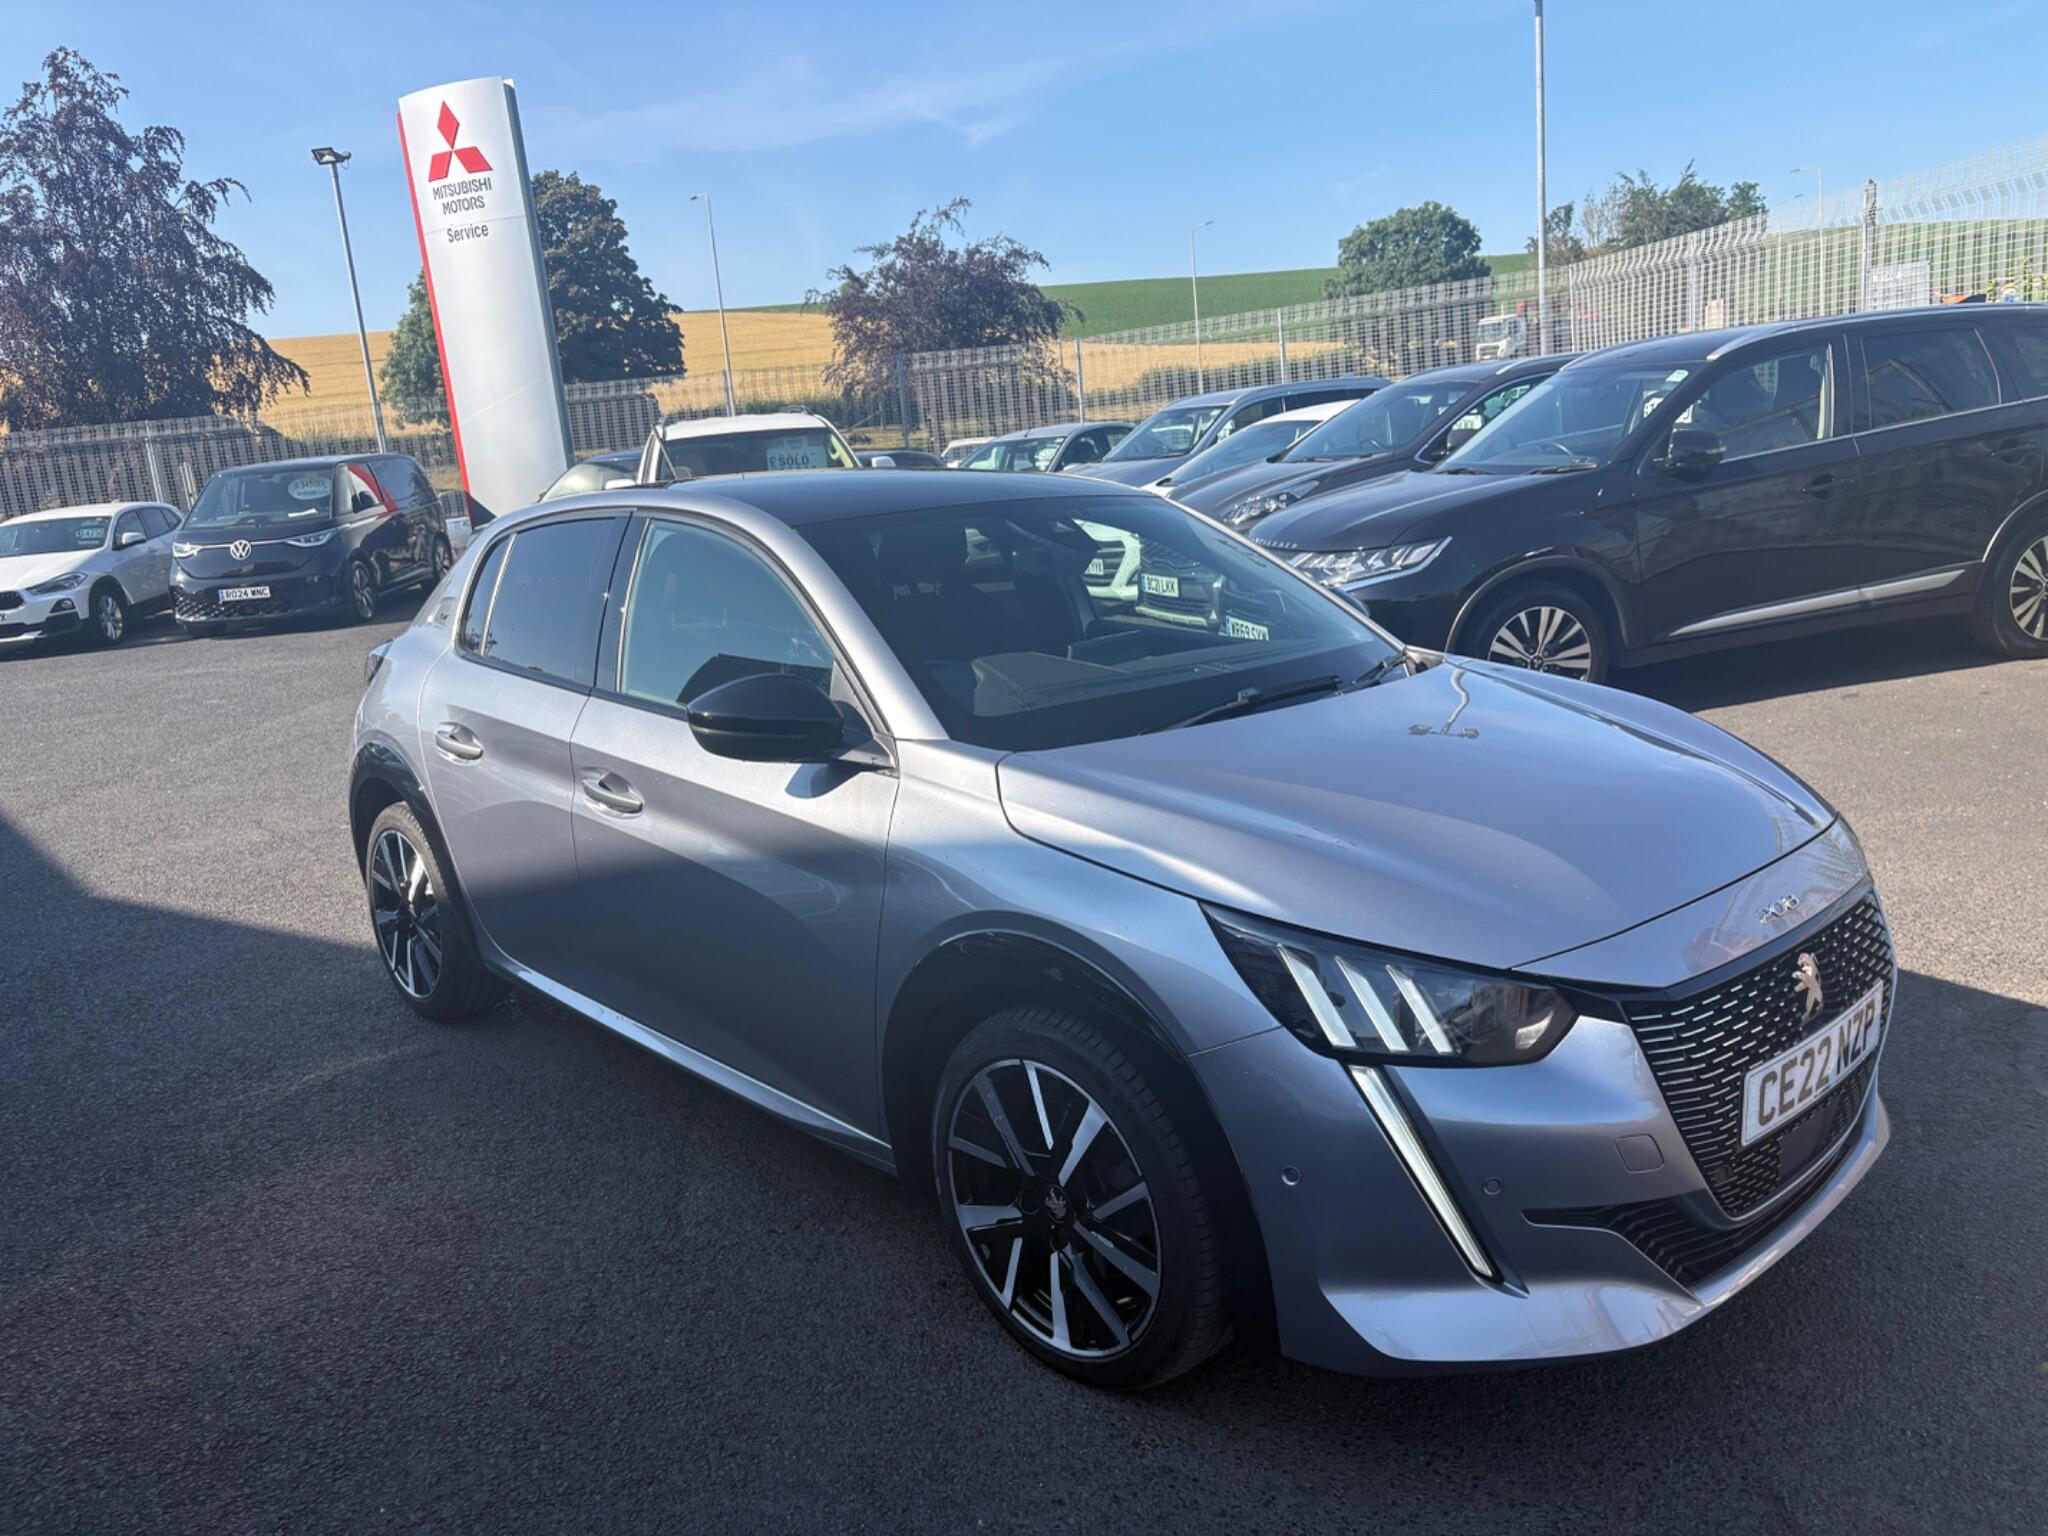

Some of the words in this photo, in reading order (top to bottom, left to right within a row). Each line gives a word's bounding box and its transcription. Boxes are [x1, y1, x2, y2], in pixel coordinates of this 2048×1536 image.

[432, 177, 492, 200] MITSUBISHI
[442, 195, 486, 215] MOTORS
[447, 223, 489, 243] Service
[1758, 893, 1800, 924] 208
[1756, 1035, 1831, 1127] CE22
[1835, 1001, 1876, 1078] NZP
